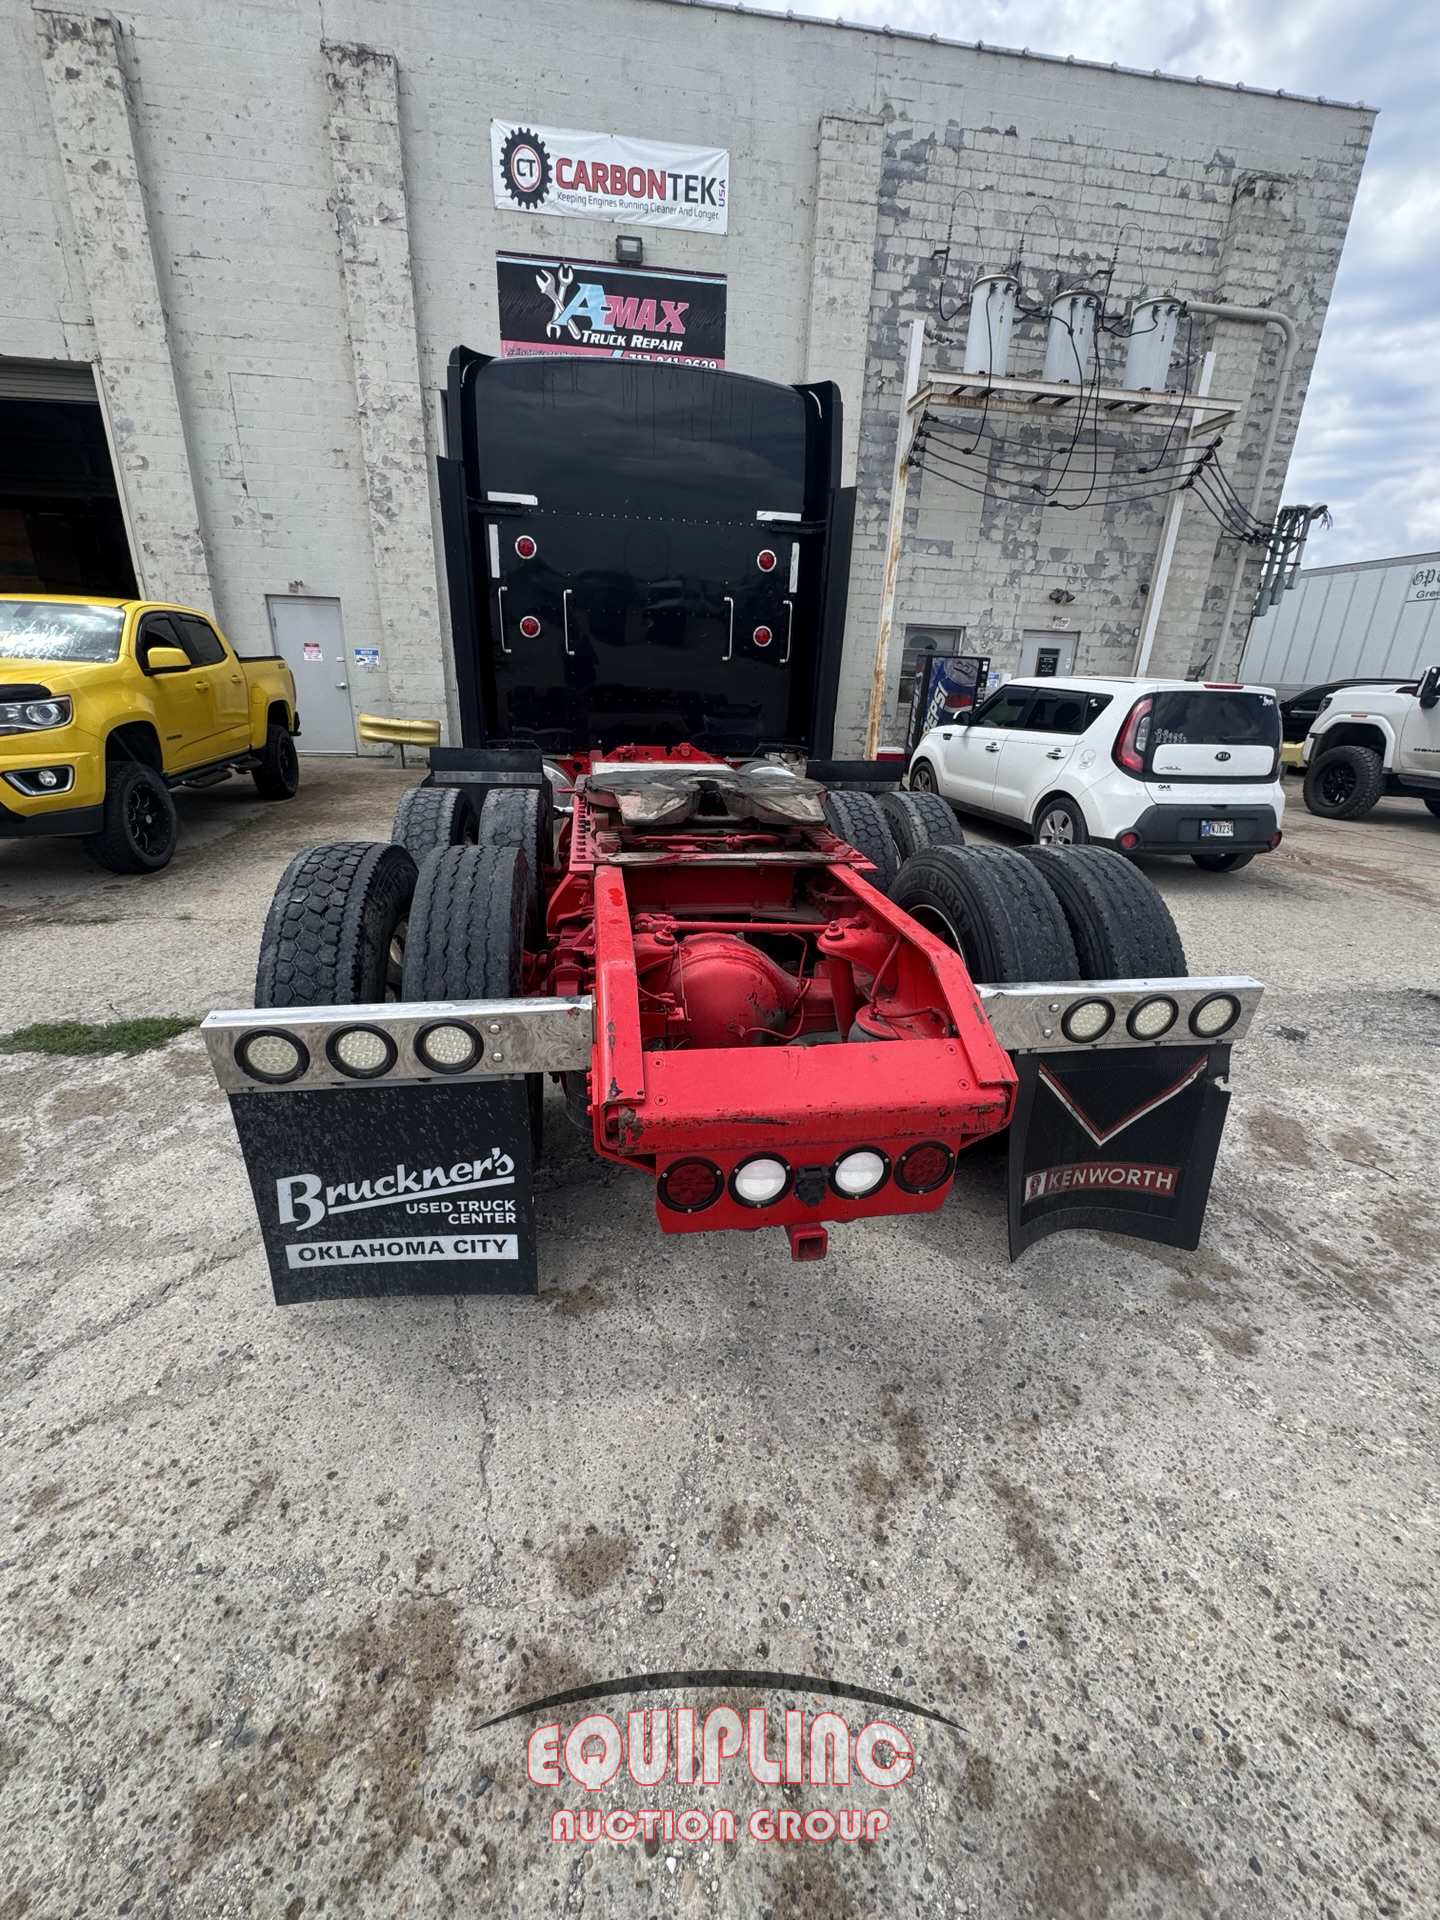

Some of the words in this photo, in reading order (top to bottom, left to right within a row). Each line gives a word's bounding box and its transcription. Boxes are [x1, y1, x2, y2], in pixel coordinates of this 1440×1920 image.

[516, 158, 536, 177] CT
[556, 158, 717, 206] CARBONTEK
[718, 179, 726, 207] USA
[557, 191, 587, 207] Keeping
[588, 195, 617, 209] Engines
[619, 200, 649, 214] Running
[650, 202, 676, 216] Cleaner
[679, 206, 693, 217] And
[694, 208, 719, 221] Longer.
[550, 282, 690, 334] A-MAX
[581, 330, 627, 347] TRUCK
[630, 335, 684, 352] REPAIR
[922, 680, 949, 732] PEPSI
[1217, 752, 1230, 760] KIA
[276, 1147, 515, 1231] Bruckner's
[1048, 1167, 1174, 1190] KENWORTH
[405, 1202, 454, 1215] USED
[457, 1199, 516, 1213] TRUCK
[447, 1211, 516, 1225] CENTER
[297, 1240, 446, 1263] OKLAHOMA
[452, 1238, 508, 1254] CITY
